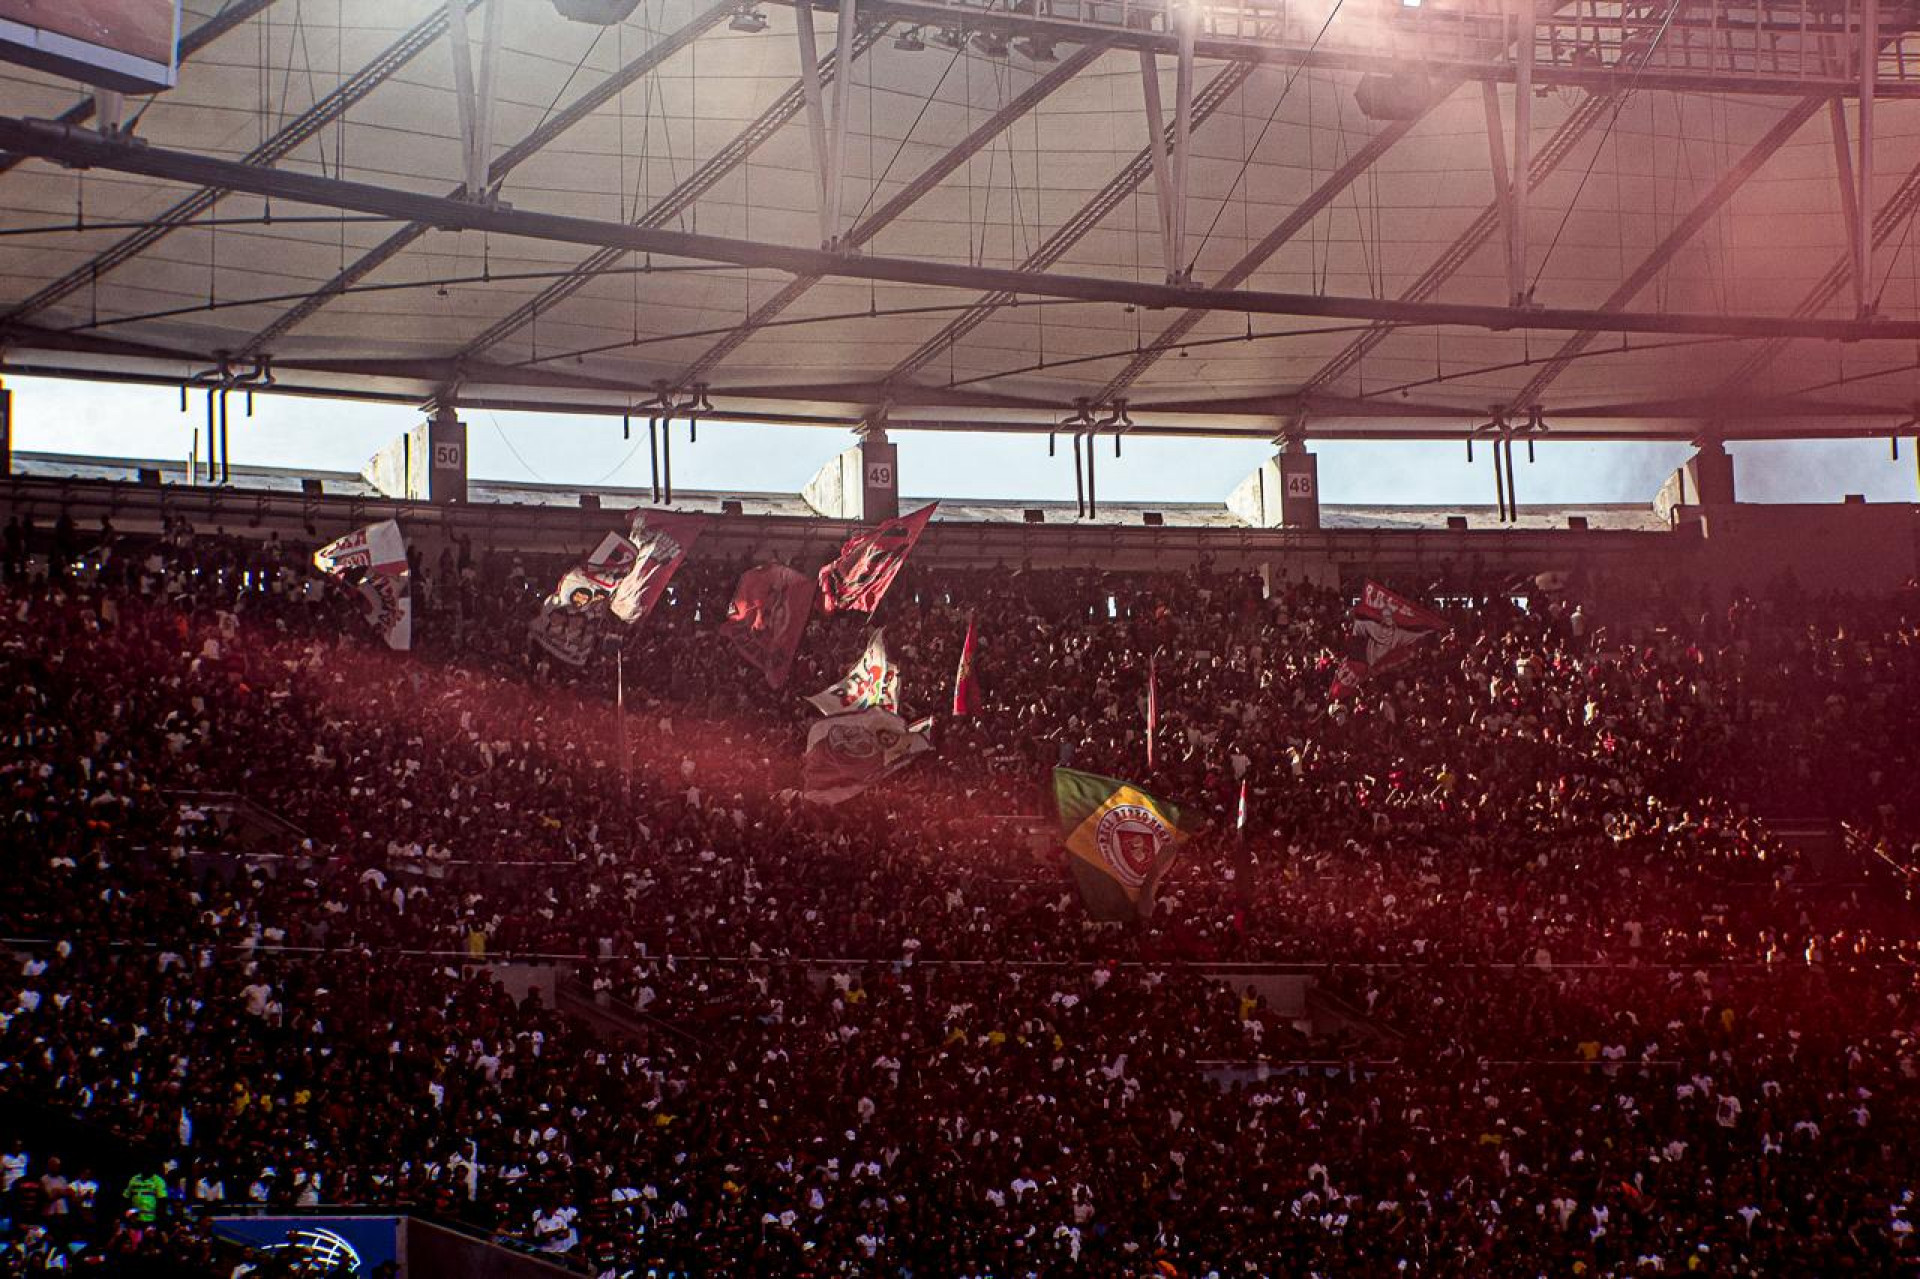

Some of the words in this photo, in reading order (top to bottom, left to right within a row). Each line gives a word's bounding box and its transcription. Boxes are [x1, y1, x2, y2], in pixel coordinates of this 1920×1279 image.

[438, 447, 458, 464] 50
[870, 468, 890, 483] 49
[1290, 478, 1310, 493] 48
